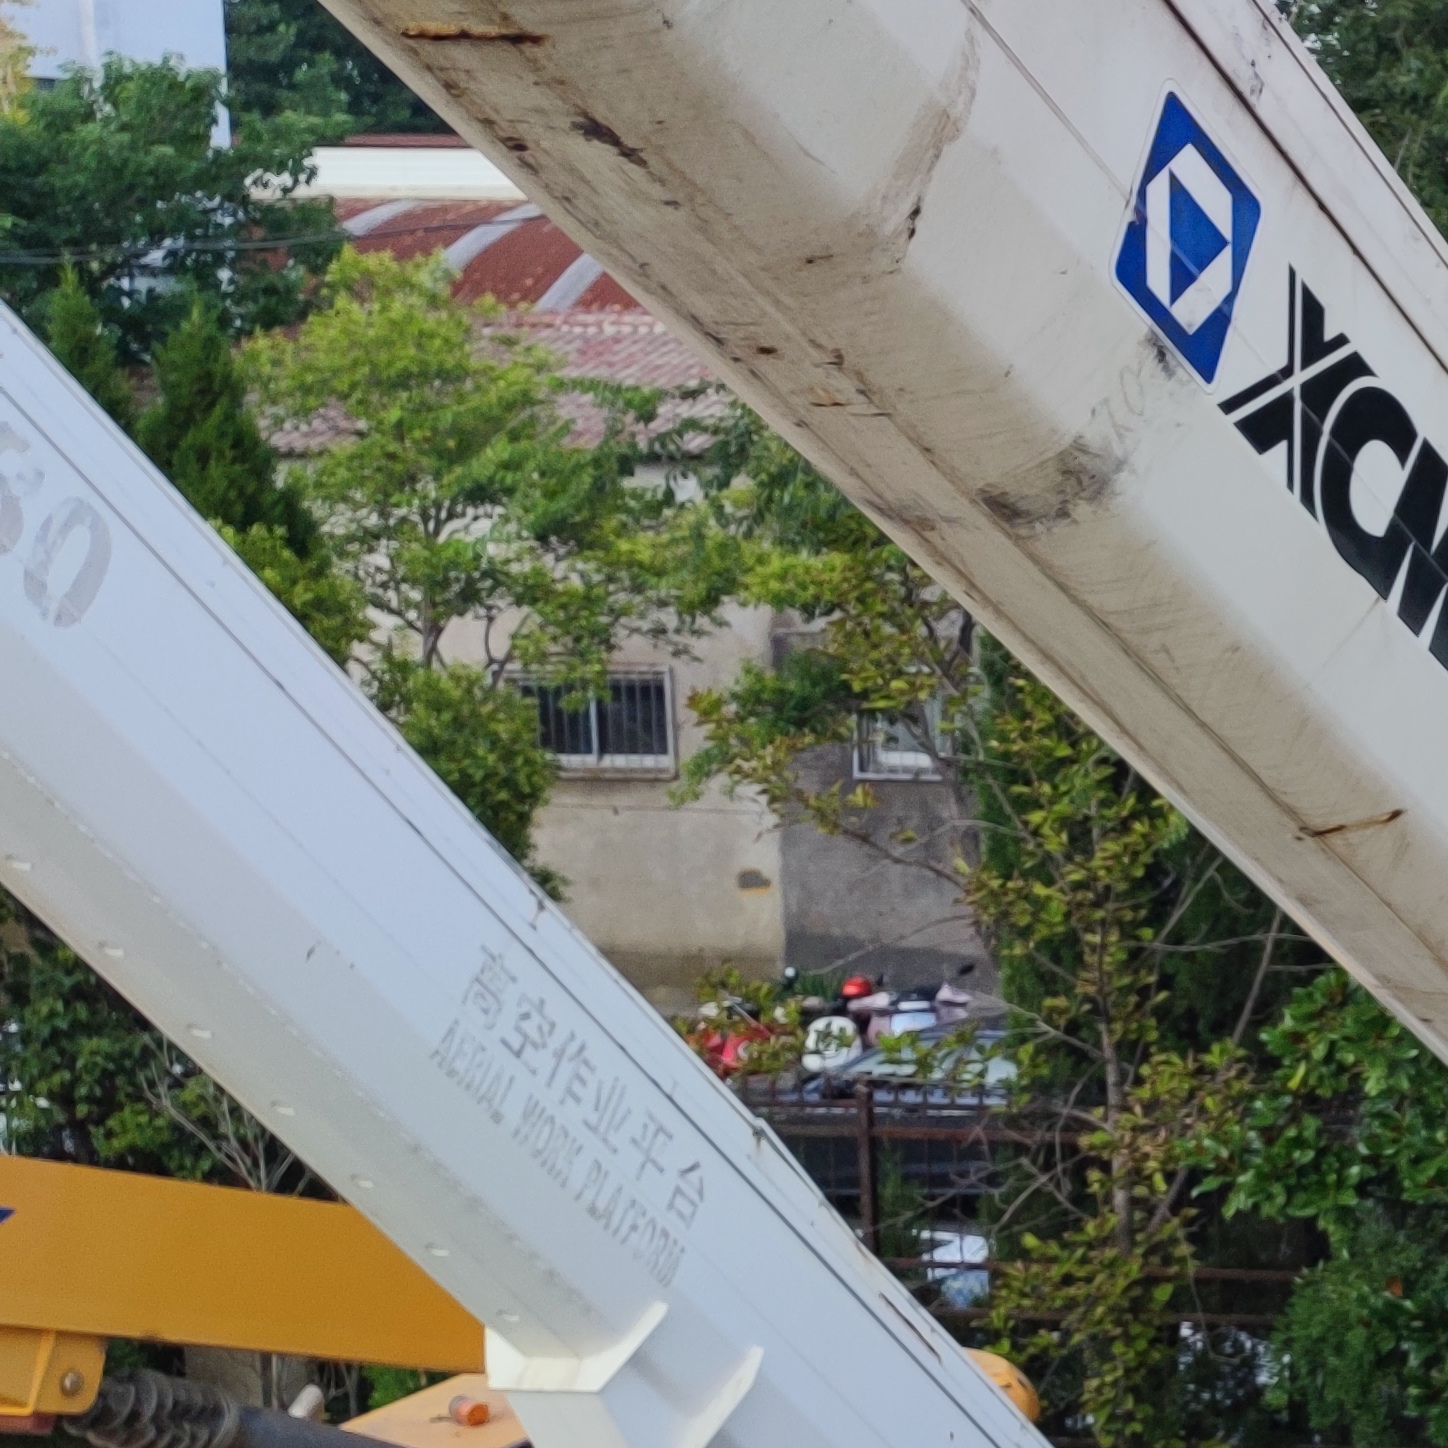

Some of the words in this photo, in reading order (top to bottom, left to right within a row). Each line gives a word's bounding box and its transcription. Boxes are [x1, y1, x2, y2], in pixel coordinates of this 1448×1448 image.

[430, 1017, 515, 1126] AERIAL
[512, 1092, 584, 1189] WORK
[575, 1158, 685, 1288] PLATFORM
[461, 944, 704, 1231] 高空作业平台
